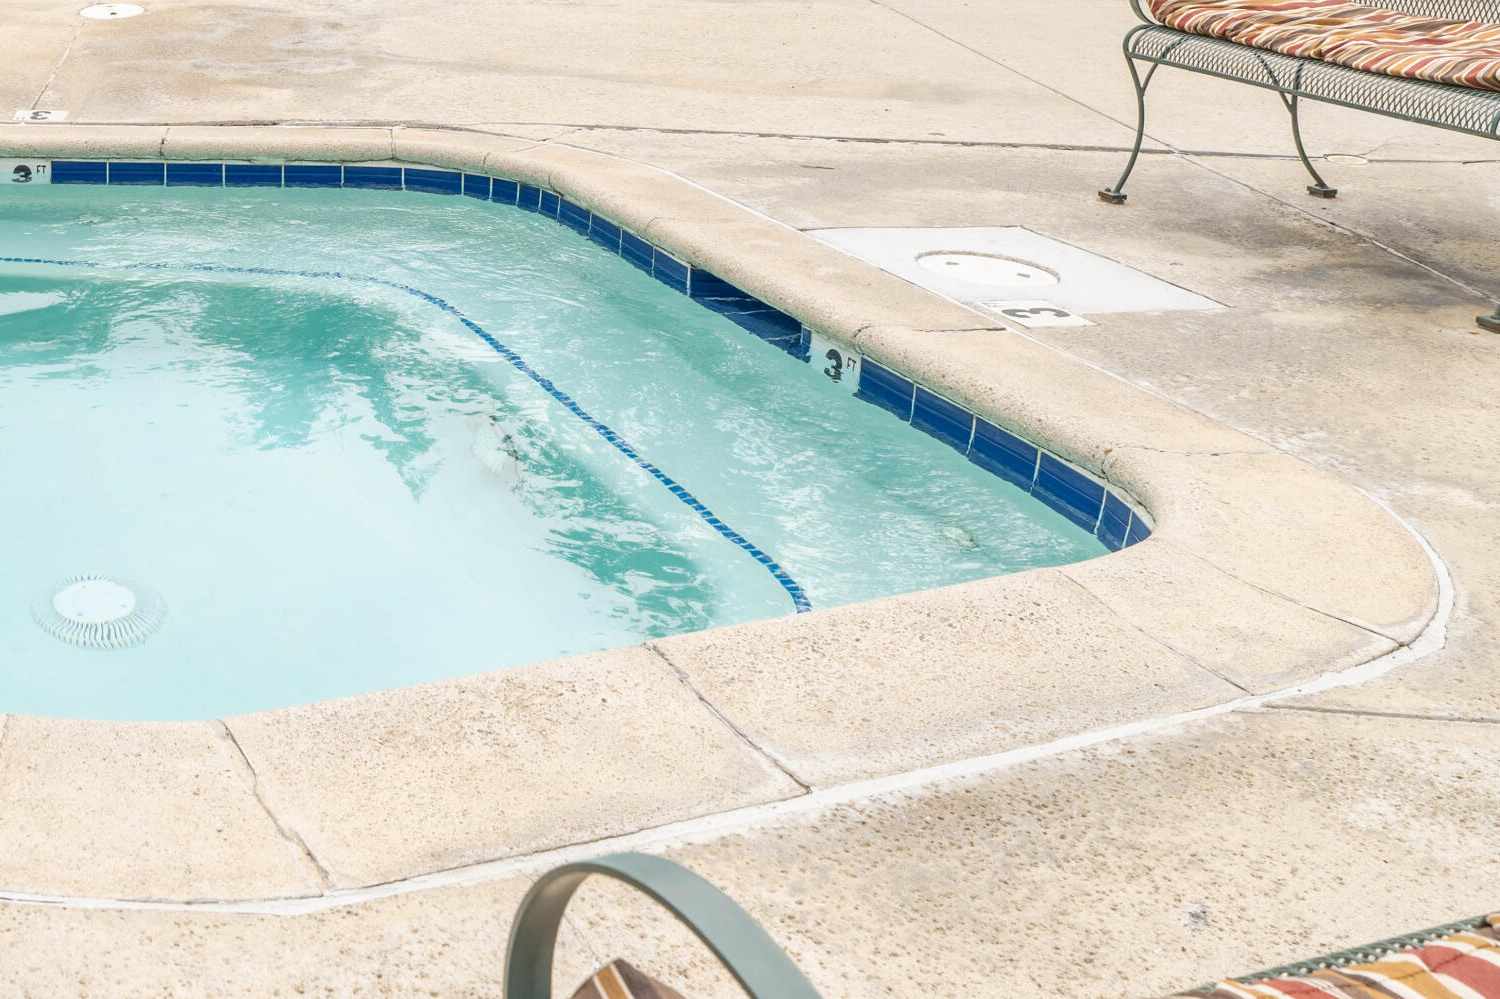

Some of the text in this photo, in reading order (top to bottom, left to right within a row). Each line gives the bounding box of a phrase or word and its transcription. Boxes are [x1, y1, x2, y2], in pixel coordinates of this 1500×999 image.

[30, 110, 52, 120] 3
[12, 164, 47, 183] 3 FT
[1001, 307, 1071, 319] 3
[823, 348, 844, 384] 3
